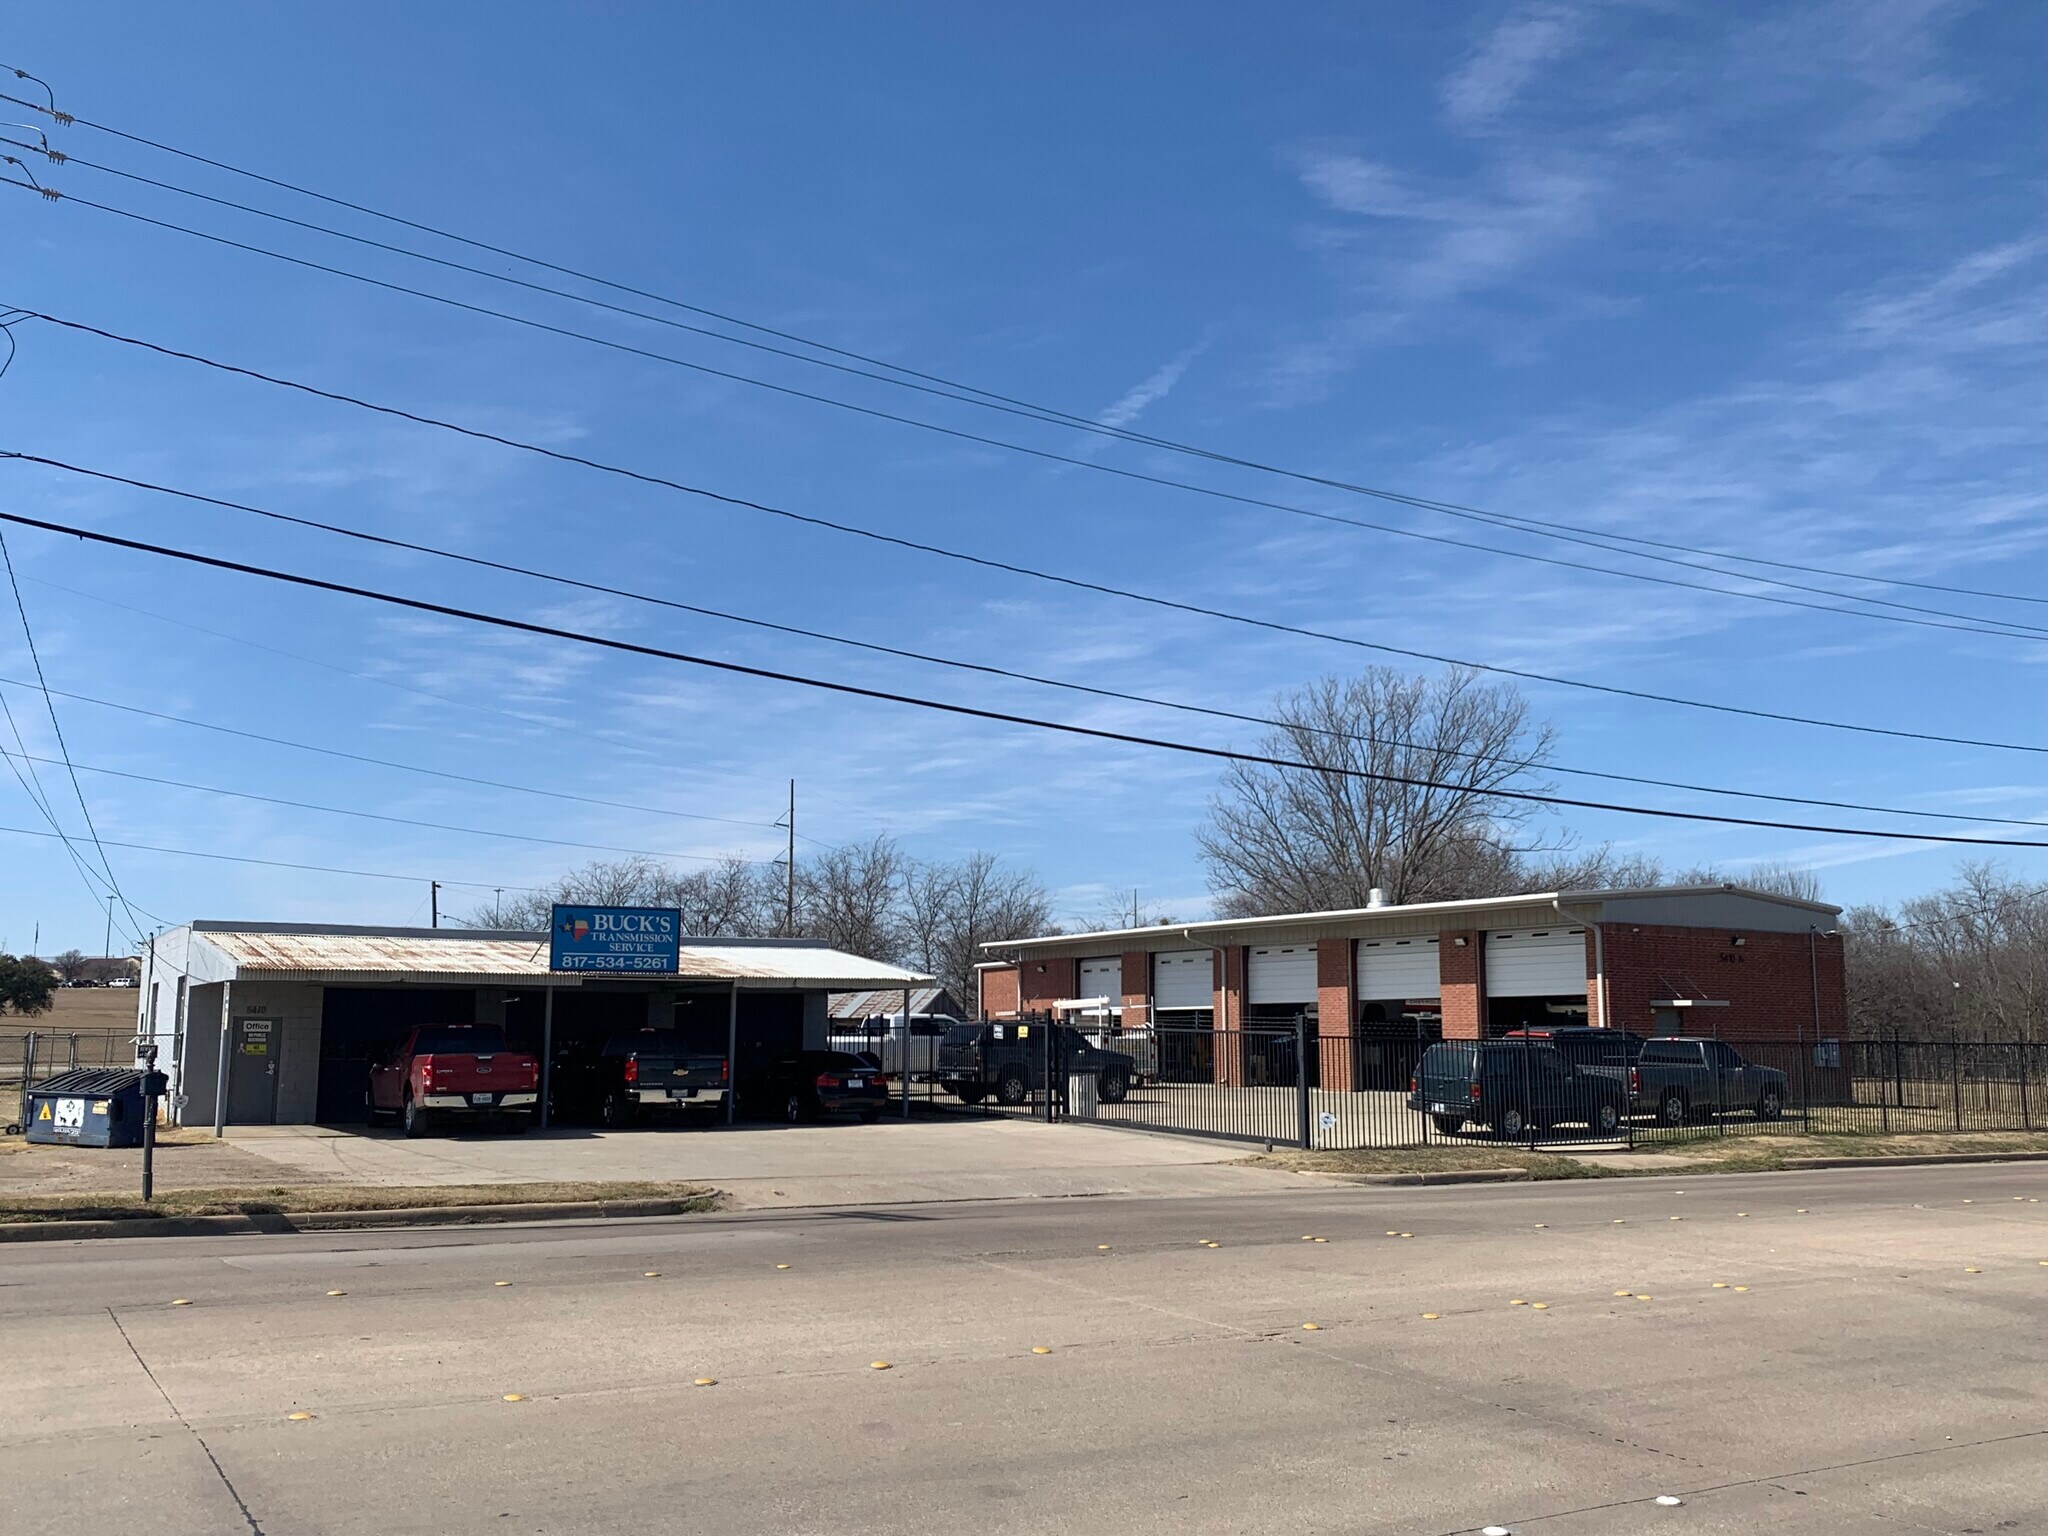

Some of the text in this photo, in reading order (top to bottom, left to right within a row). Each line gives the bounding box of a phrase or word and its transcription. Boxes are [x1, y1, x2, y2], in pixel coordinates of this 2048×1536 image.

[593, 914, 671, 933] BUCK'S
[591, 932, 673, 943] TRANSMISSION
[609, 943, 655, 952] SERVICE
[562, 956, 668, 969] 817-534-5261
